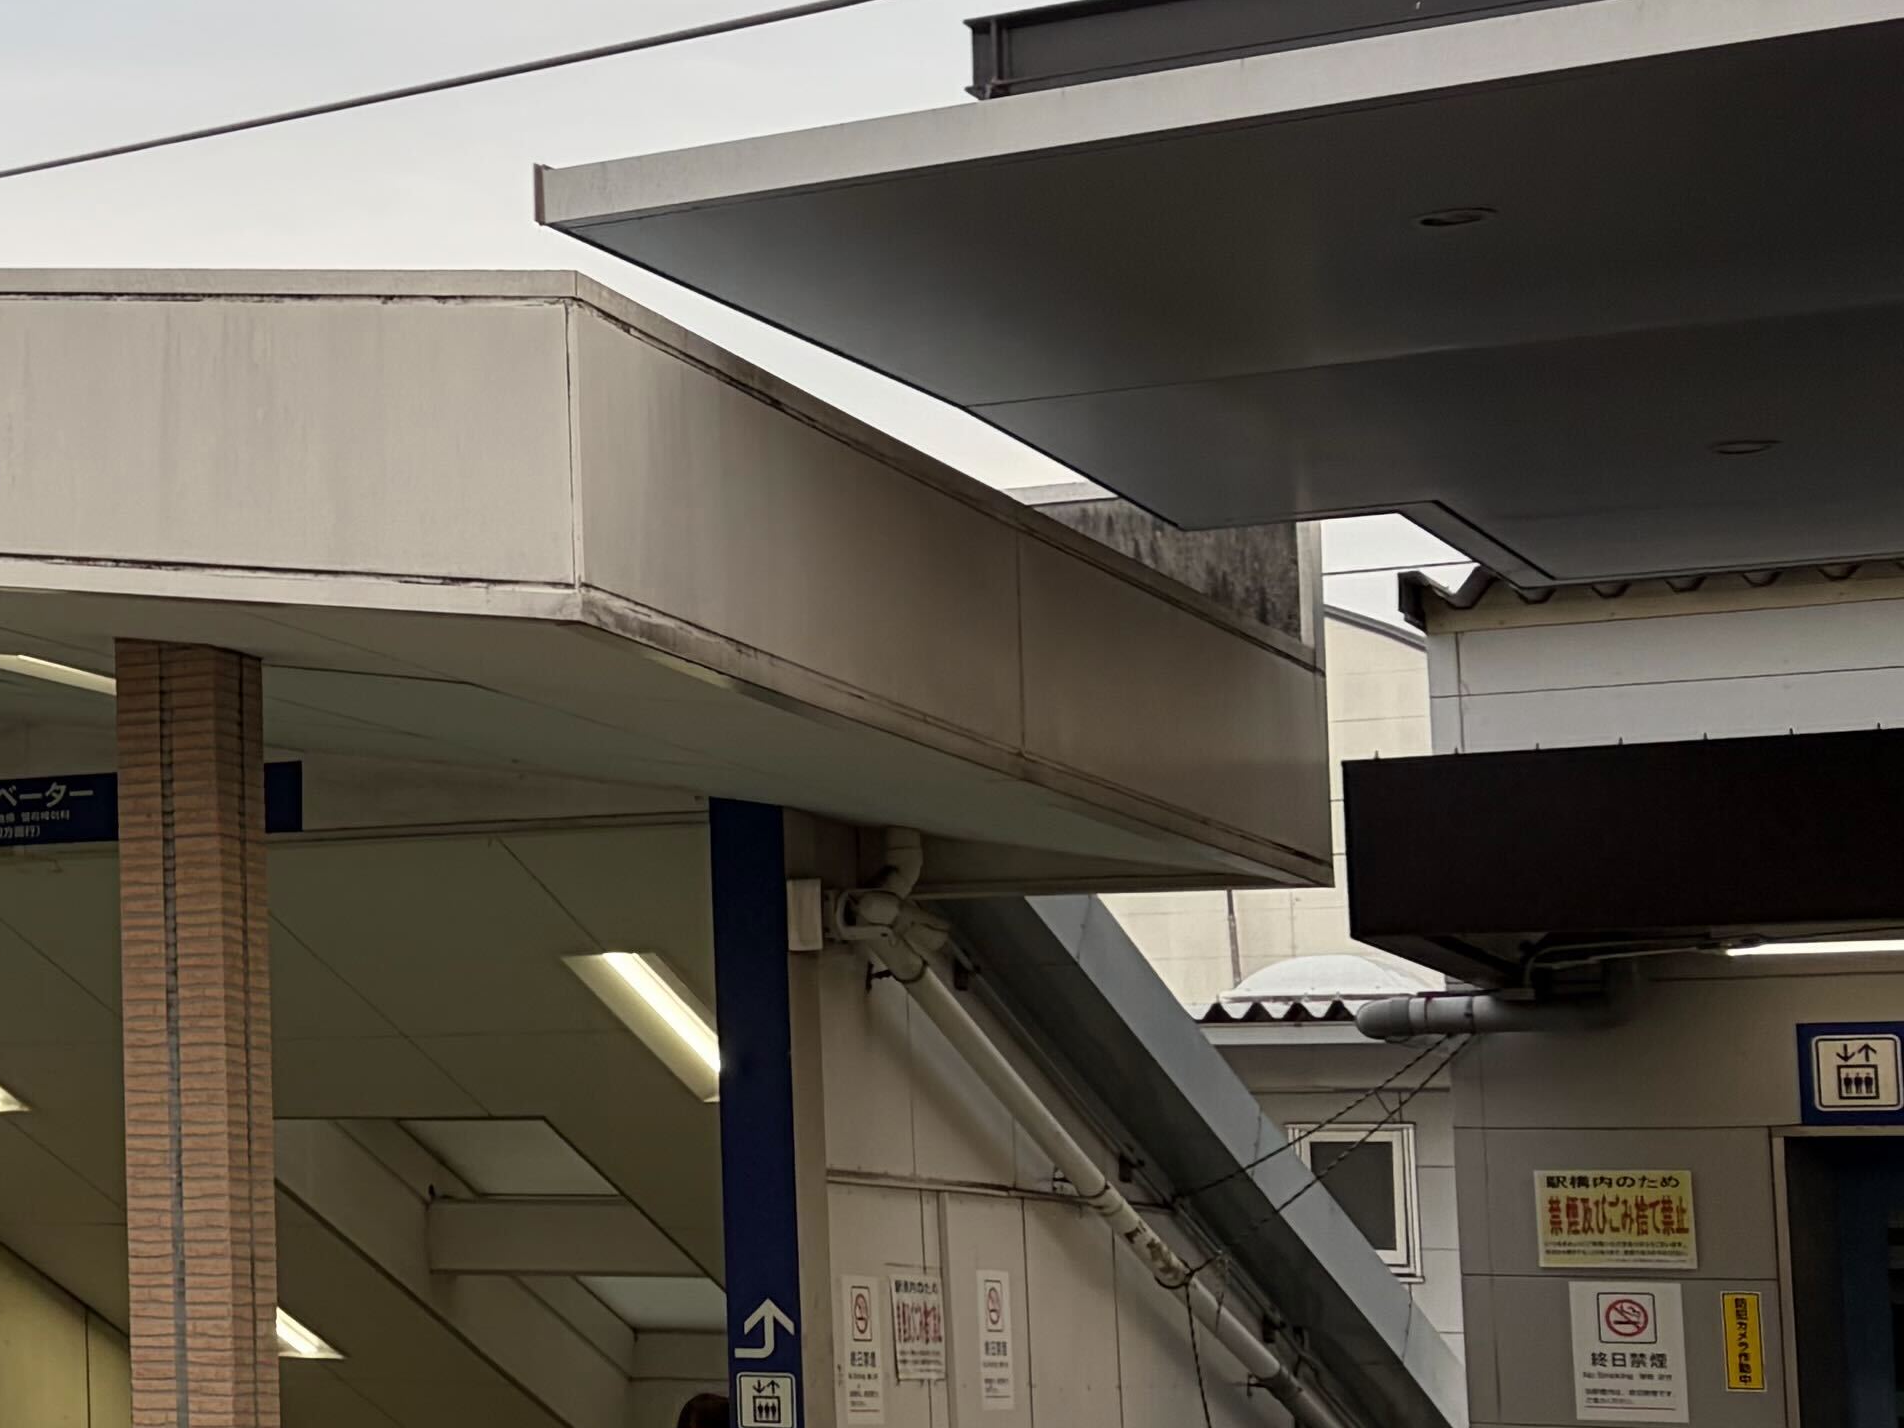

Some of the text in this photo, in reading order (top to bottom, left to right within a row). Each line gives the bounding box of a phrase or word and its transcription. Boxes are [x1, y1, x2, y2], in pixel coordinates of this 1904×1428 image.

[1545, 1174, 1681, 1189] 駅構内のため
[1547, 1193, 1690, 1237] 禁煙及びごみ捨て禁止
[1590, 1352, 1669, 1370] 終日禁煙
